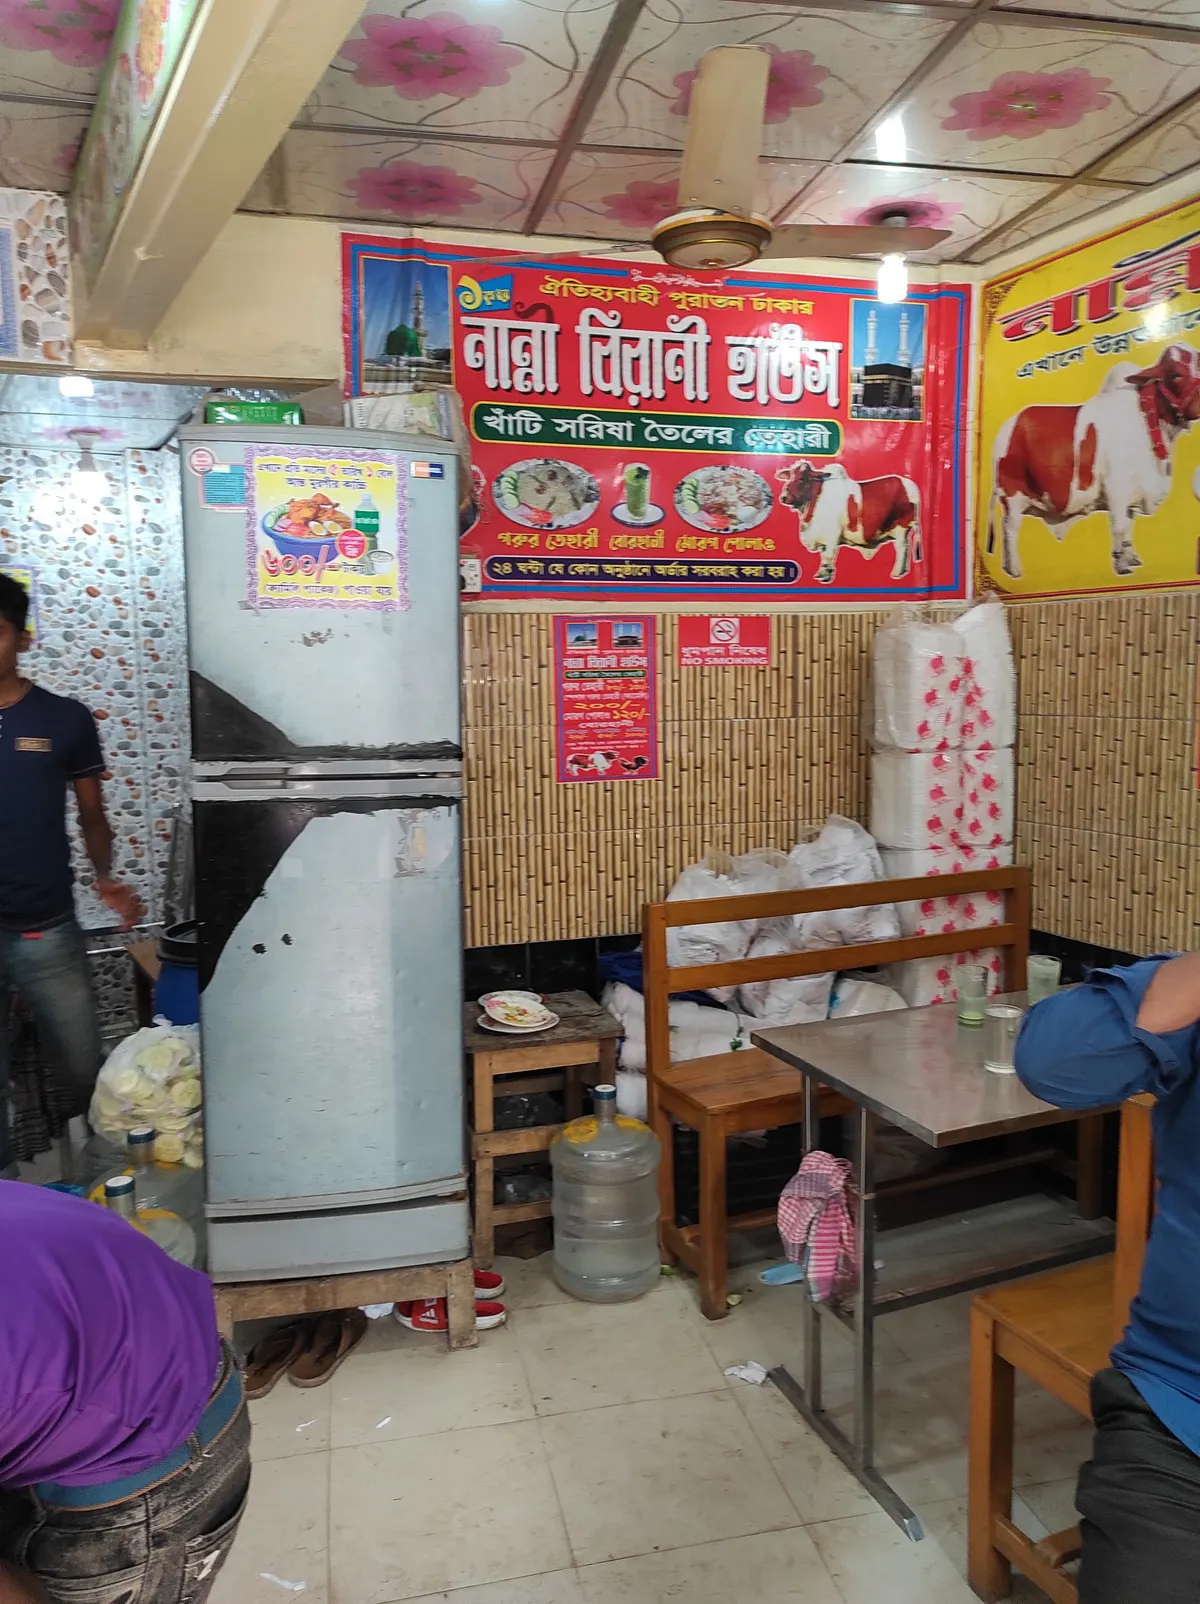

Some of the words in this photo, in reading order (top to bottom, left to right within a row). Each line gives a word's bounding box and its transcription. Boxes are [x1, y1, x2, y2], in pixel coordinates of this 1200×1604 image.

[539, 275, 660, 306] ঐতিহ্যবাহী
[669, 290, 745, 311] পুরাতন
[749, 296, 815, 315] ঢাকার
[460, 316, 561, 394] নান্না
[575, 307, 711, 407] বিরানী
[725, 323, 842, 407] হাউস
[1016, 345, 1088, 378] এখানে
[482, 408, 545, 436] খাঁটি
[550, 413, 636, 442] সরিষা
[640, 417, 734, 446] তৈলের
[744, 423, 832, 450] তেহারী
[329, 463, 339, 476] ৫
[497, 532, 540, 549] গরুর
[545, 527, 599, 551] তেহারী
[675, 534, 720, 552] মোরগ
[723, 536, 776, 553] পোলাও
[492, 562, 513, 575] ২৪
[548, 563, 565, 575] যে
[567, 563, 599, 576] কোন
[601, 560, 652, 579] অনুষ্ঠানে
[653, 561, 689, 577] অর্ডার
[690, 565, 739, 578] সরবরাহ
[740, 565, 765, 577] করা
[766, 566, 786, 578] হয়
[681, 657, 703, 665] NO
[704, 657, 768, 665] SMOKING
[573, 700, 640, 710] ২০০/-
[612, 707, 651, 719] ১২০/-
